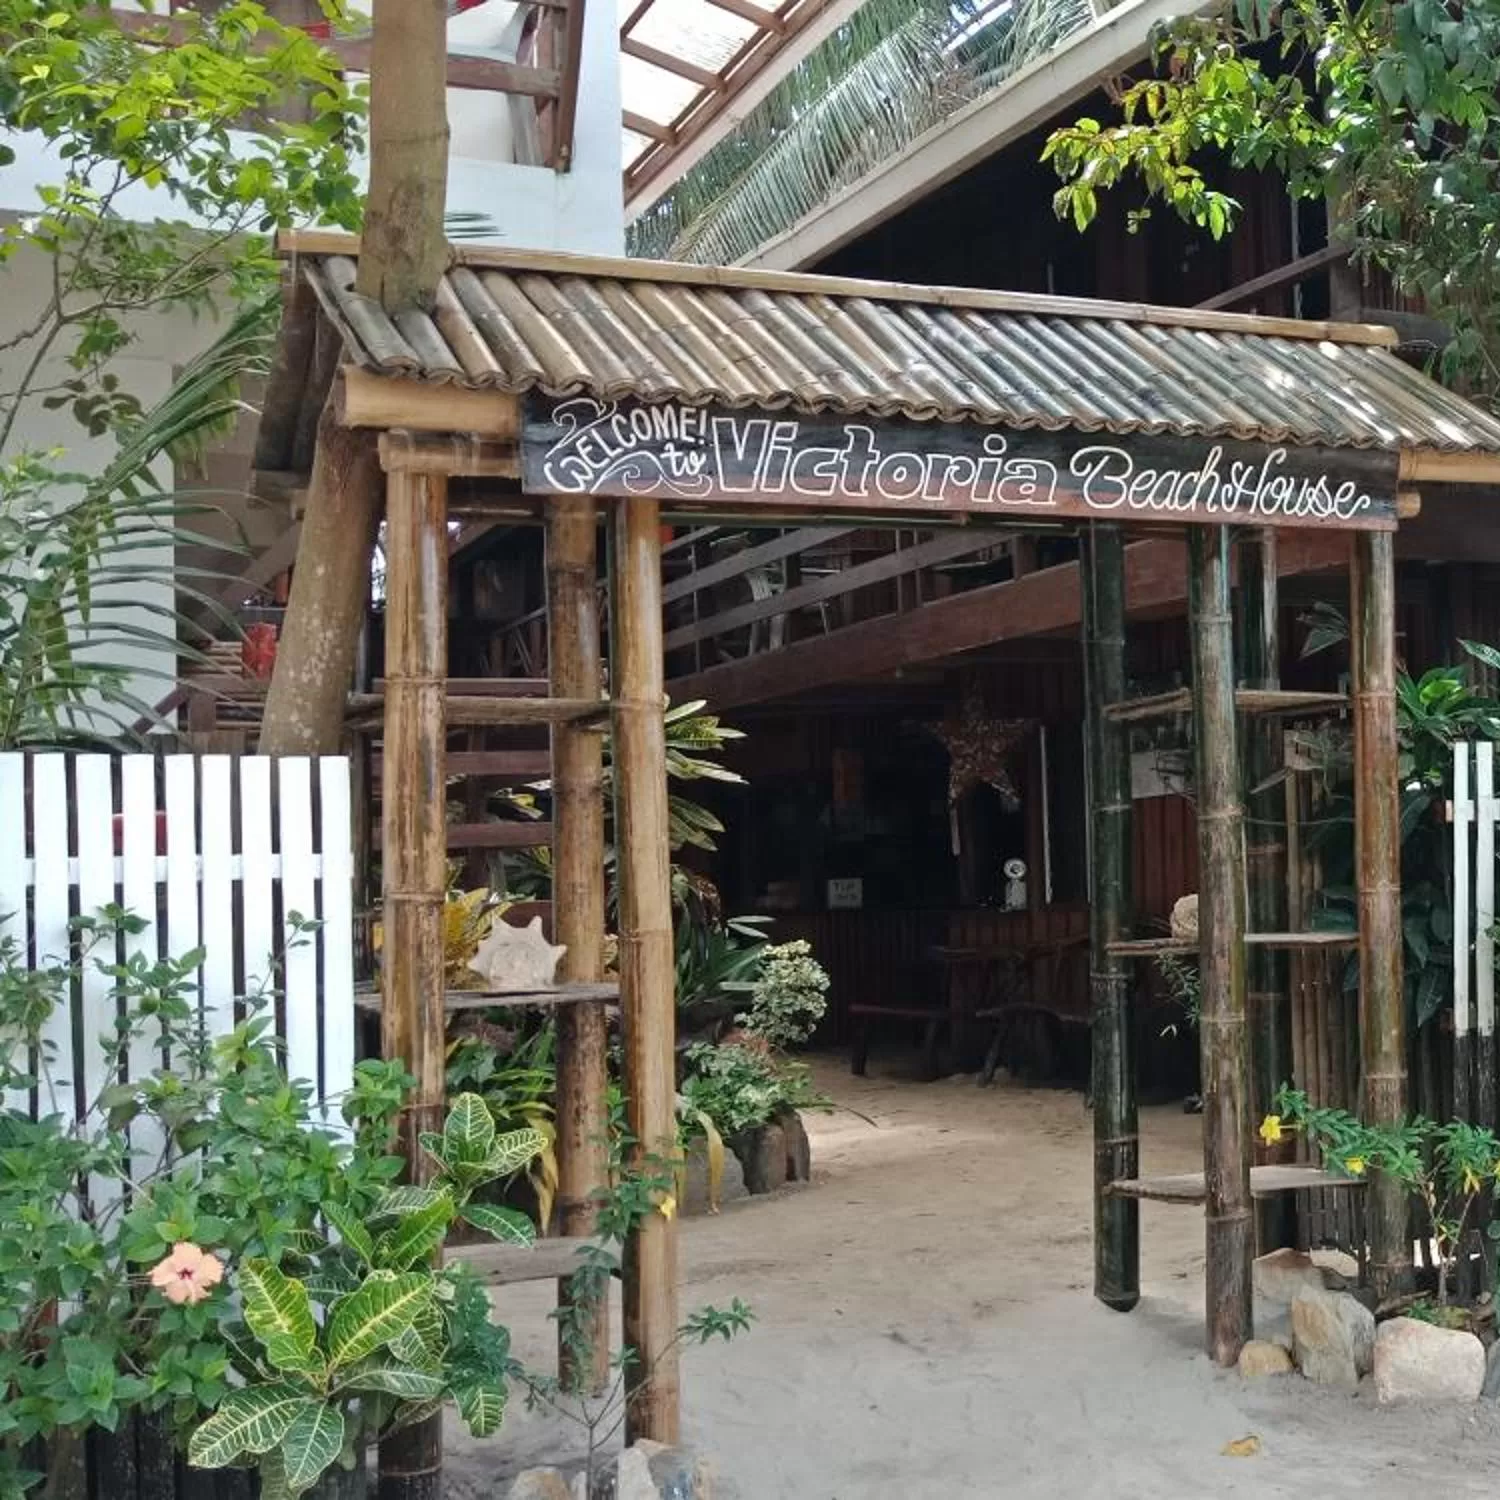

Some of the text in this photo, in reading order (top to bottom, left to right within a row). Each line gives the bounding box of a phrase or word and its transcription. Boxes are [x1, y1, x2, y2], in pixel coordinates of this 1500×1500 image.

[661, 444, 706, 478] to
[711, 416, 1371, 520] Victoria Beach House
